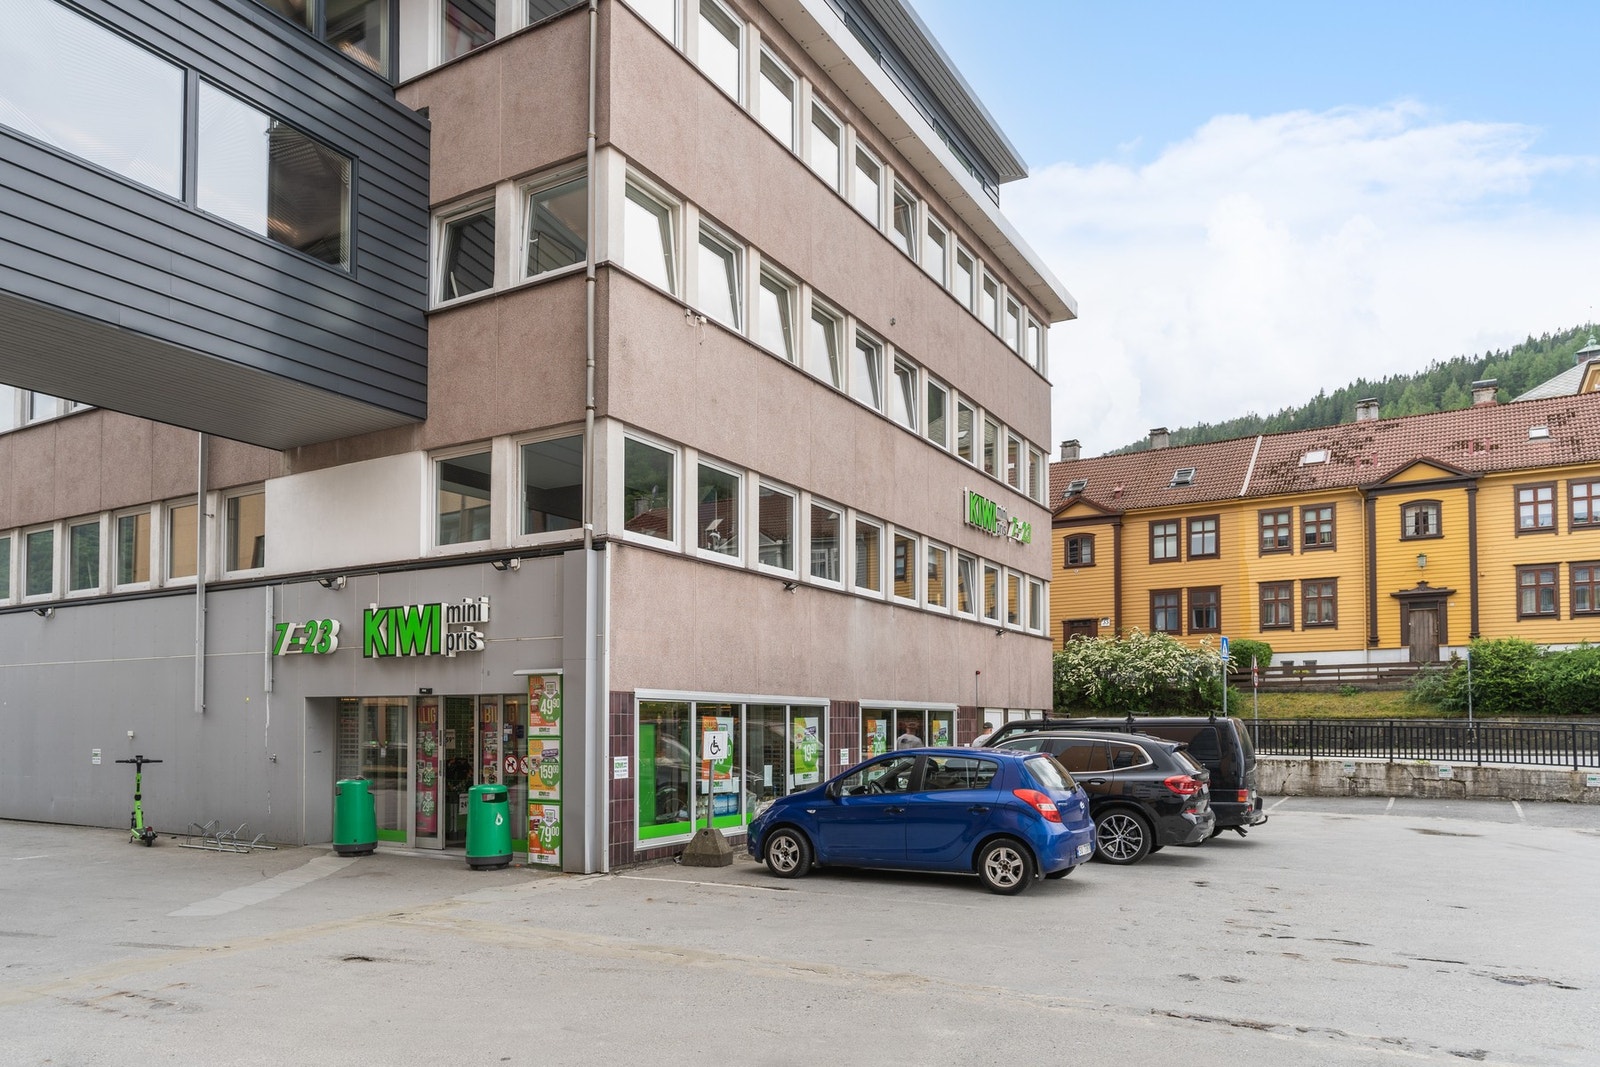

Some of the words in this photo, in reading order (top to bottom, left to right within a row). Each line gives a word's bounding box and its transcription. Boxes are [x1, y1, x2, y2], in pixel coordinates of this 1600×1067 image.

[969, 490, 997, 534] KIWI
[447, 597, 485, 623] mini
[273, 619, 335, 656] 7-23
[363, 602, 443, 658] KIWI
[446, 626, 480, 656] pris
